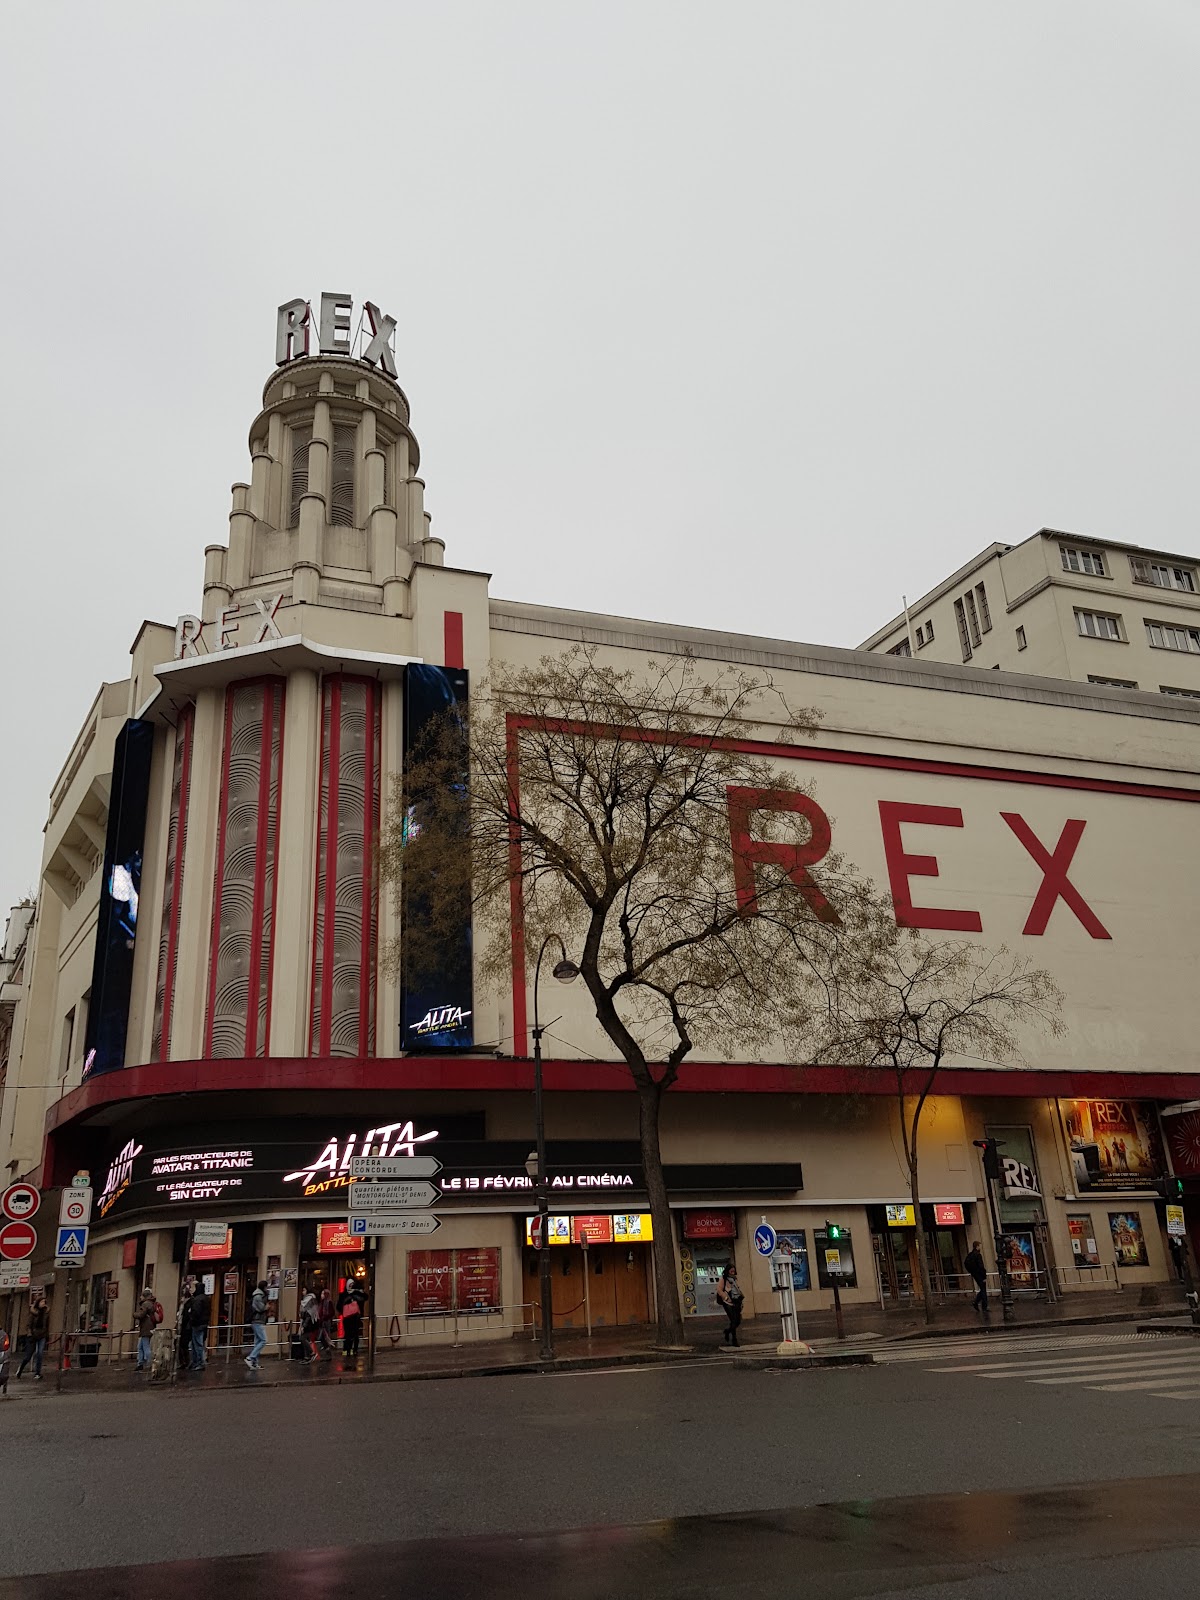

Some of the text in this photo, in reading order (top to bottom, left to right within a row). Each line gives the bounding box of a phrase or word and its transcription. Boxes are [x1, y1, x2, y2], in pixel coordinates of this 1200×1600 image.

[275, 292, 398, 380] REX
[174, 593, 284, 659] REX
[726, 785, 1113, 940] REX
[409, 1007, 472, 1031] ALITA
[1095, 1102, 1128, 1123] REX
[153, 1157, 166, 1165] PAR
[166, 1155, 180, 1164] LES
[180, 1151, 239, 1162] PRODUCTEURS
[283, 1121, 439, 1186] ALITA
[151, 1162, 192, 1175] AVATAR
[201, 1158, 254, 1170] TITANIC
[441, 1173, 634, 1189] LE 13 FÉVRI AU CINÉMA
[1003, 1158, 1039, 1193] REX
[166, 1183, 175, 1191] LE
[175, 1180, 229, 1190] RÉALISATEUR
[169, 1187, 223, 1201] SIN CITY
[304, 1176, 358, 1196] BATTLE
[355, 1220, 365, 1232] P
[410, 1220, 430, 1228] Denis
[696, 1218, 723, 1227] BORNES
[1011, 1259, 1023, 1267] REX
[416, 1274, 443, 1291] REX
